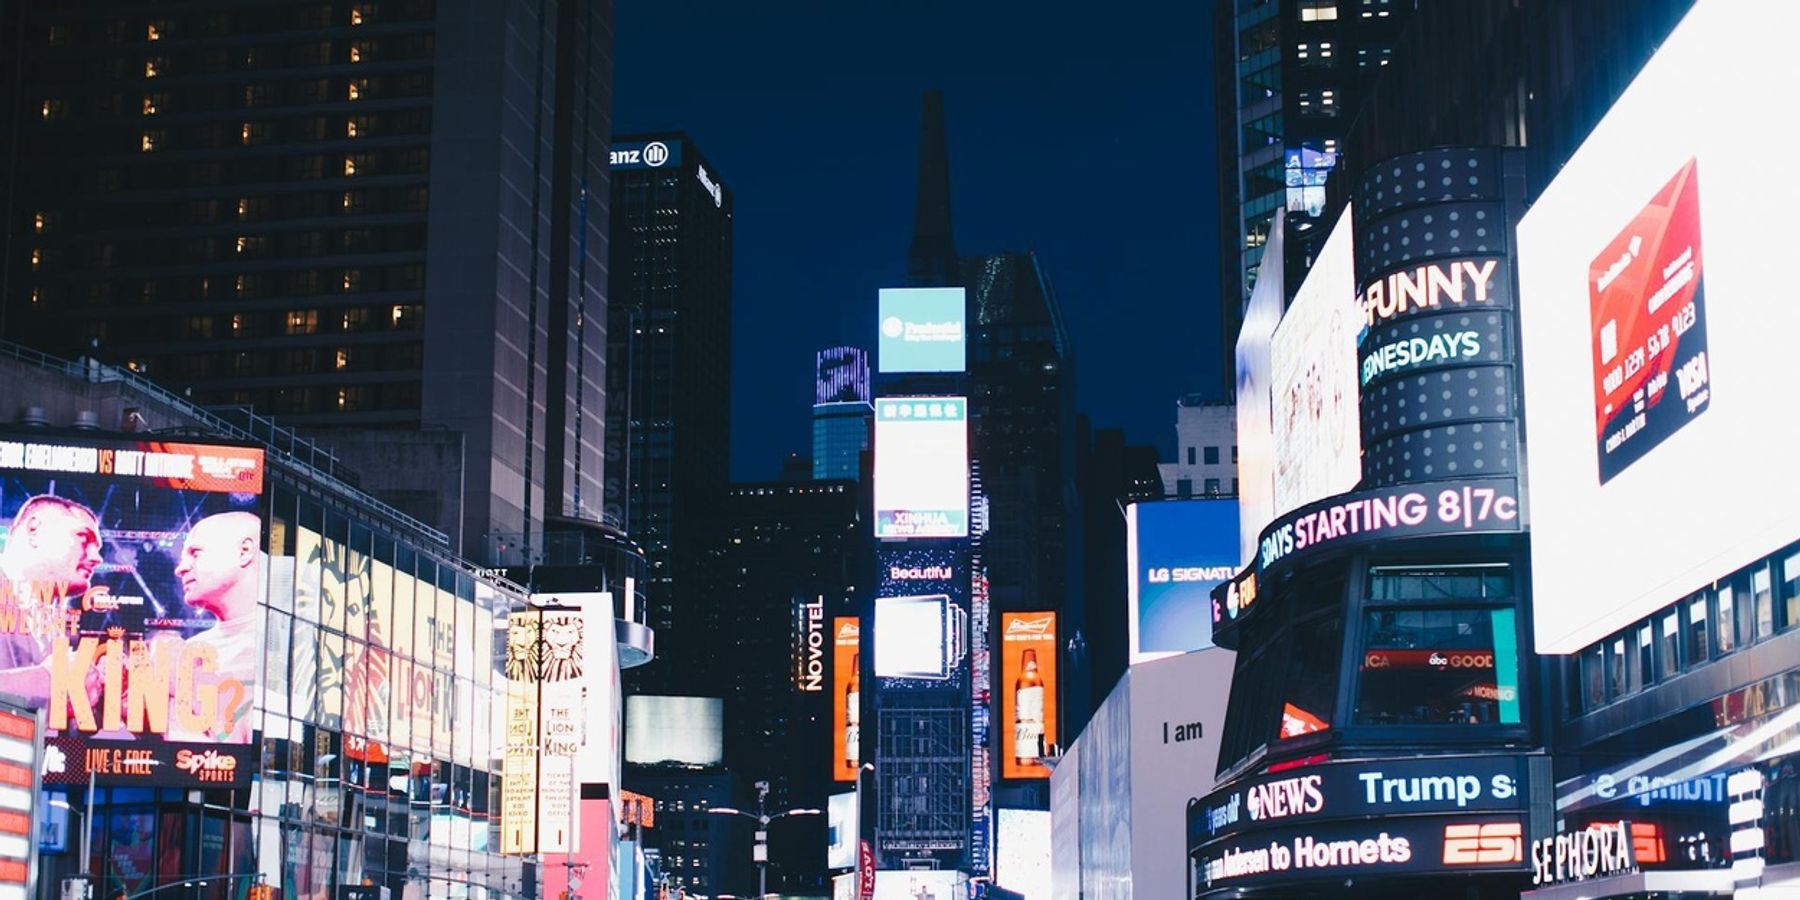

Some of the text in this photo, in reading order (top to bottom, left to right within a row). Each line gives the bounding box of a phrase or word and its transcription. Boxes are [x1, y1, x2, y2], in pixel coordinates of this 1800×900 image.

[1368, 261, 1496, 318] FUNNY
[99, 449, 113, 473] VS
[1295, 493, 1426, 549] STARTING
[890, 566, 952, 579] Beautiful
[1148, 567, 1169, 582] LG
[806, 594, 824, 691] NOVOTEL
[48, 635, 245, 734] KING?
[551, 708, 569, 718] THE
[546, 720, 574, 736] LION
[1163, 722, 1202, 744] I am
[544, 738, 578, 757] KING
[86, 748, 110, 773] LIVE
[113, 750, 121, 773] &
[125, 750, 153, 775] FREE
[176, 749, 237, 774] Spike
[199, 770, 235, 782] SPORTS
[1259, 775, 1324, 820] NEWS
[1359, 773, 1480, 806] Trump
[1491, 775, 1517, 798] s
[1270, 842, 1290, 870] to
[1294, 832, 1410, 869] Hornets
[1443, 822, 1522, 864] ES
[1532, 820, 1631, 885] SEPHORA
